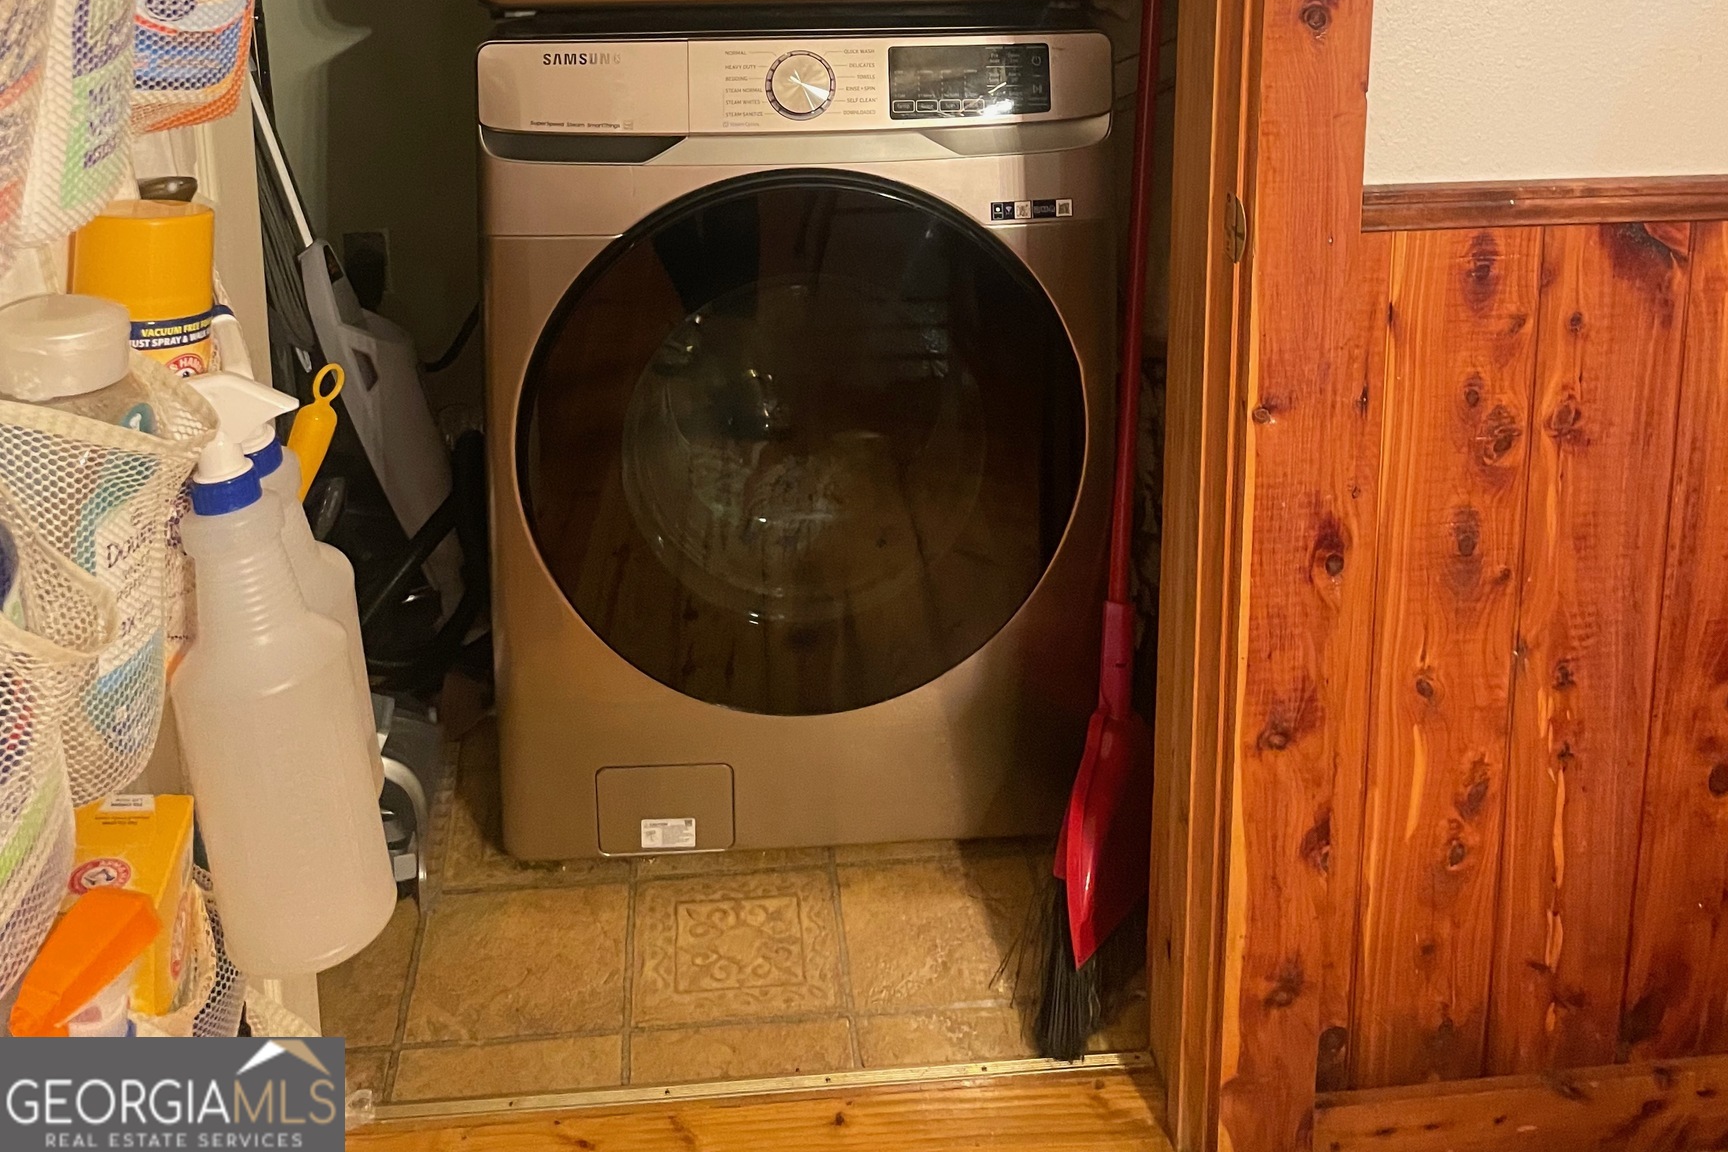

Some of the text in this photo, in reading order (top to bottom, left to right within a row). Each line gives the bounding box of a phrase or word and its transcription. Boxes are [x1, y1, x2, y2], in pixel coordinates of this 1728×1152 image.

[543, 53, 621, 65] SAMSUNG
[141, 326, 182, 338] VACUUM
[152, 334, 181, 347] SPRAY
